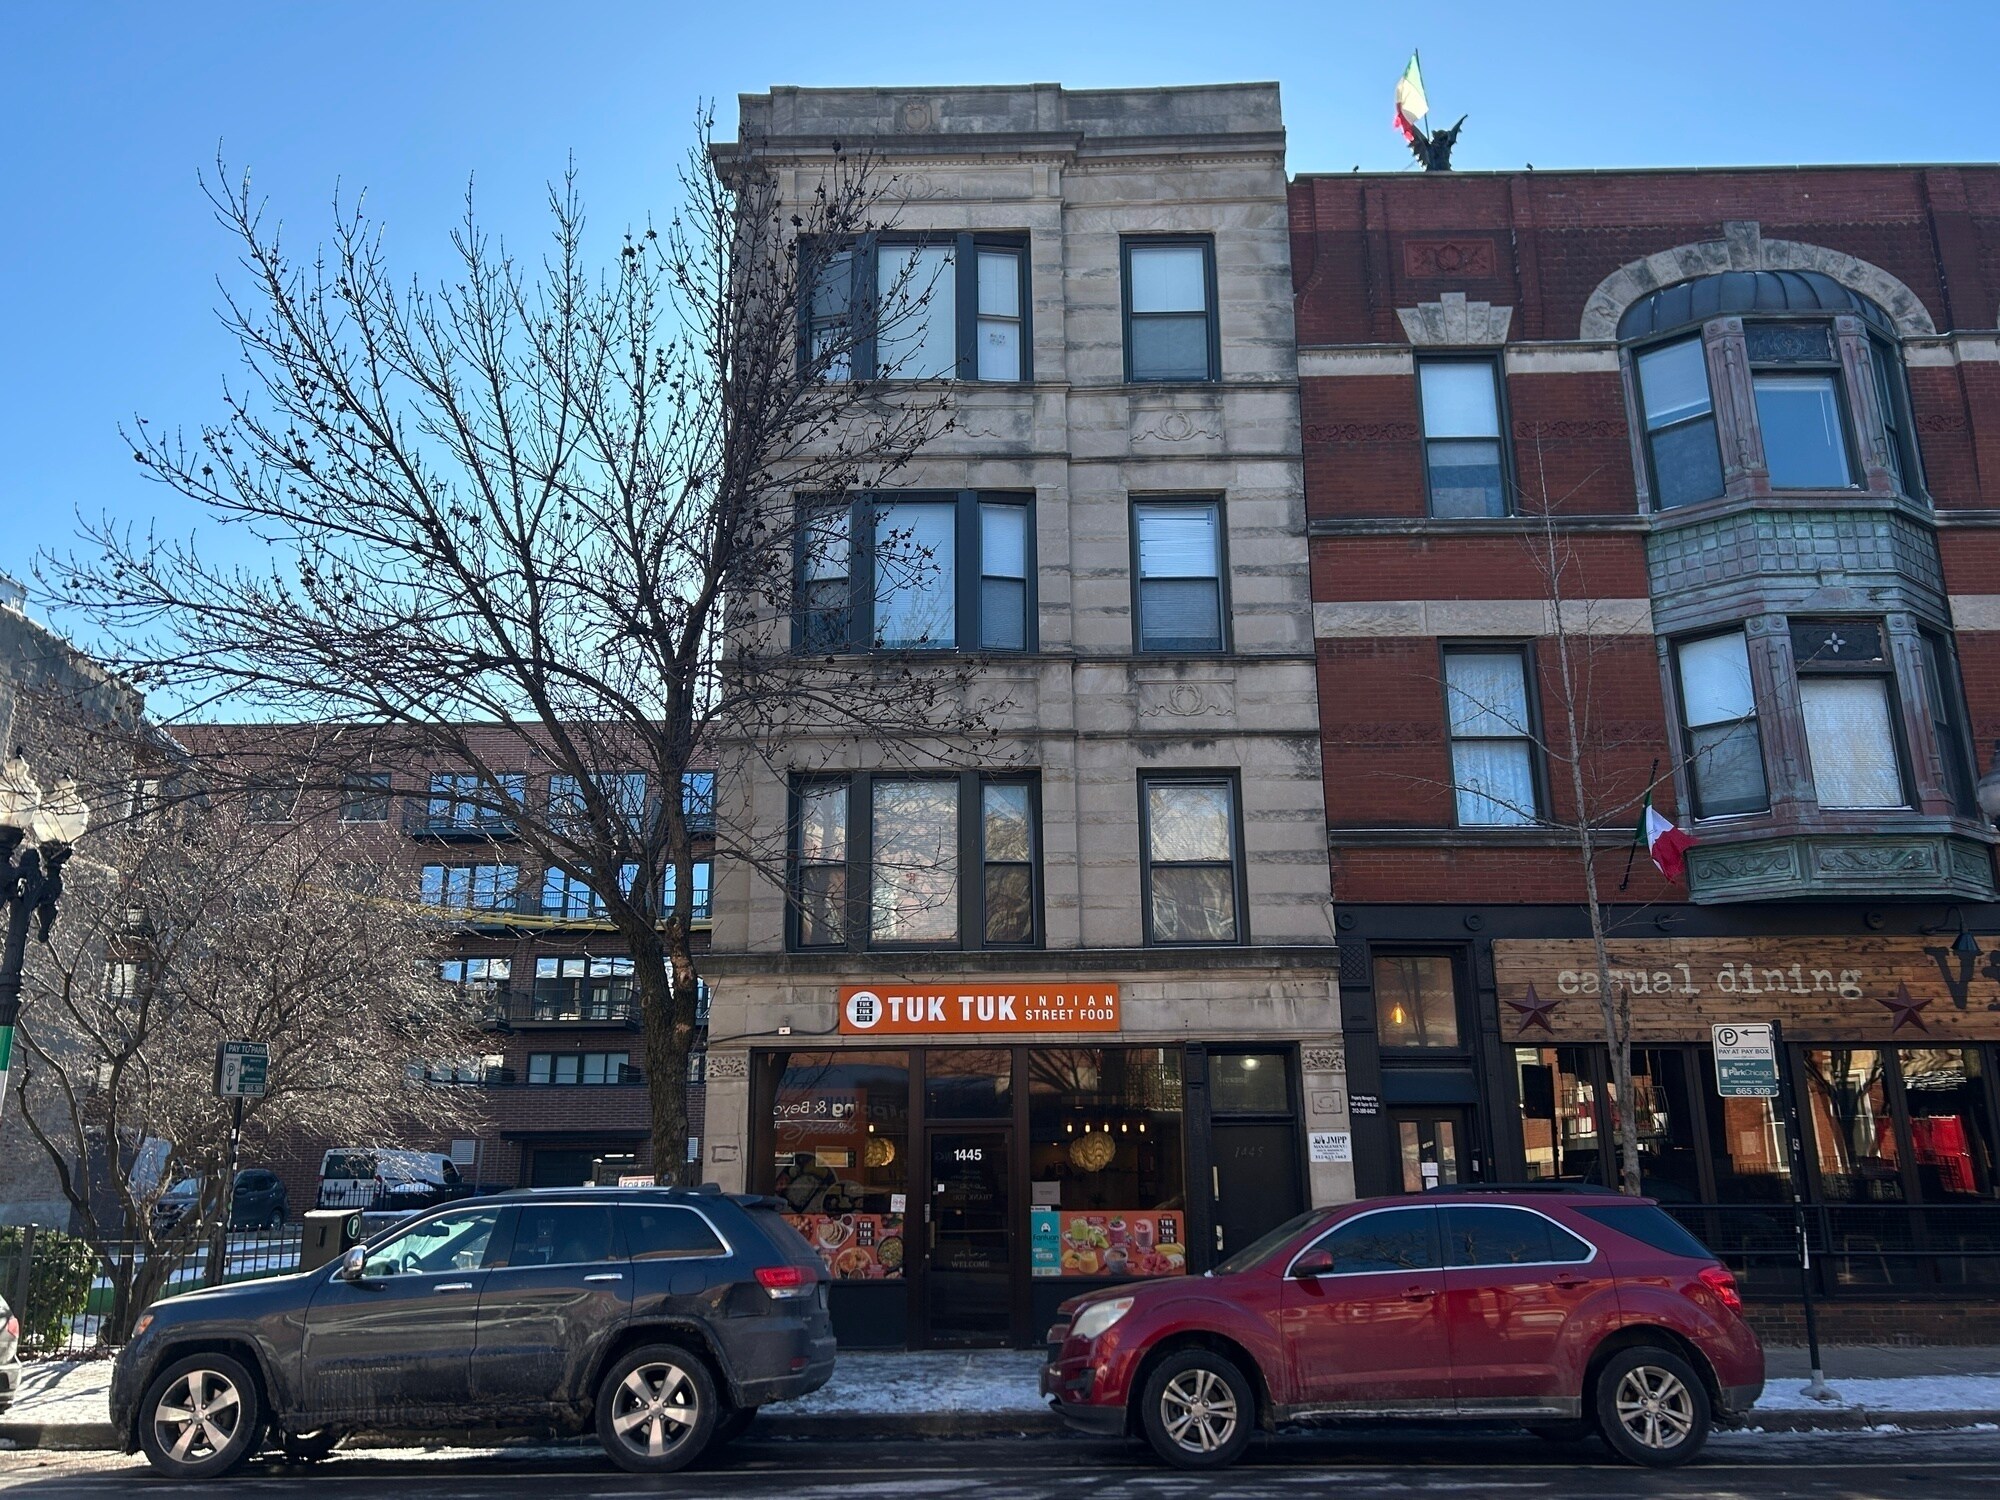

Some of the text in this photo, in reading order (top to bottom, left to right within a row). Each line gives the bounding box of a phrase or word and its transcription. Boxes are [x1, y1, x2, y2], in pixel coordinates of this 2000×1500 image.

[1717, 962, 1862, 999] dining
[1025, 995, 1113, 1006] INDIAN
[887, 995, 1017, 1022] TUK TUK
[1025, 1009, 1114, 1020] STREET FOOD
[1724, 1031, 1734, 1043] P
[228, 1044, 266, 1055] PAY TO PARK
[1728, 1067, 1772, 1077] ParkChicago
[1735, 1087, 1752, 1095] 665
[1754, 1087, 1771, 1095] 309
[1326, 1136, 1347, 1144] JMPP
[954, 1149, 982, 1161] 1445
